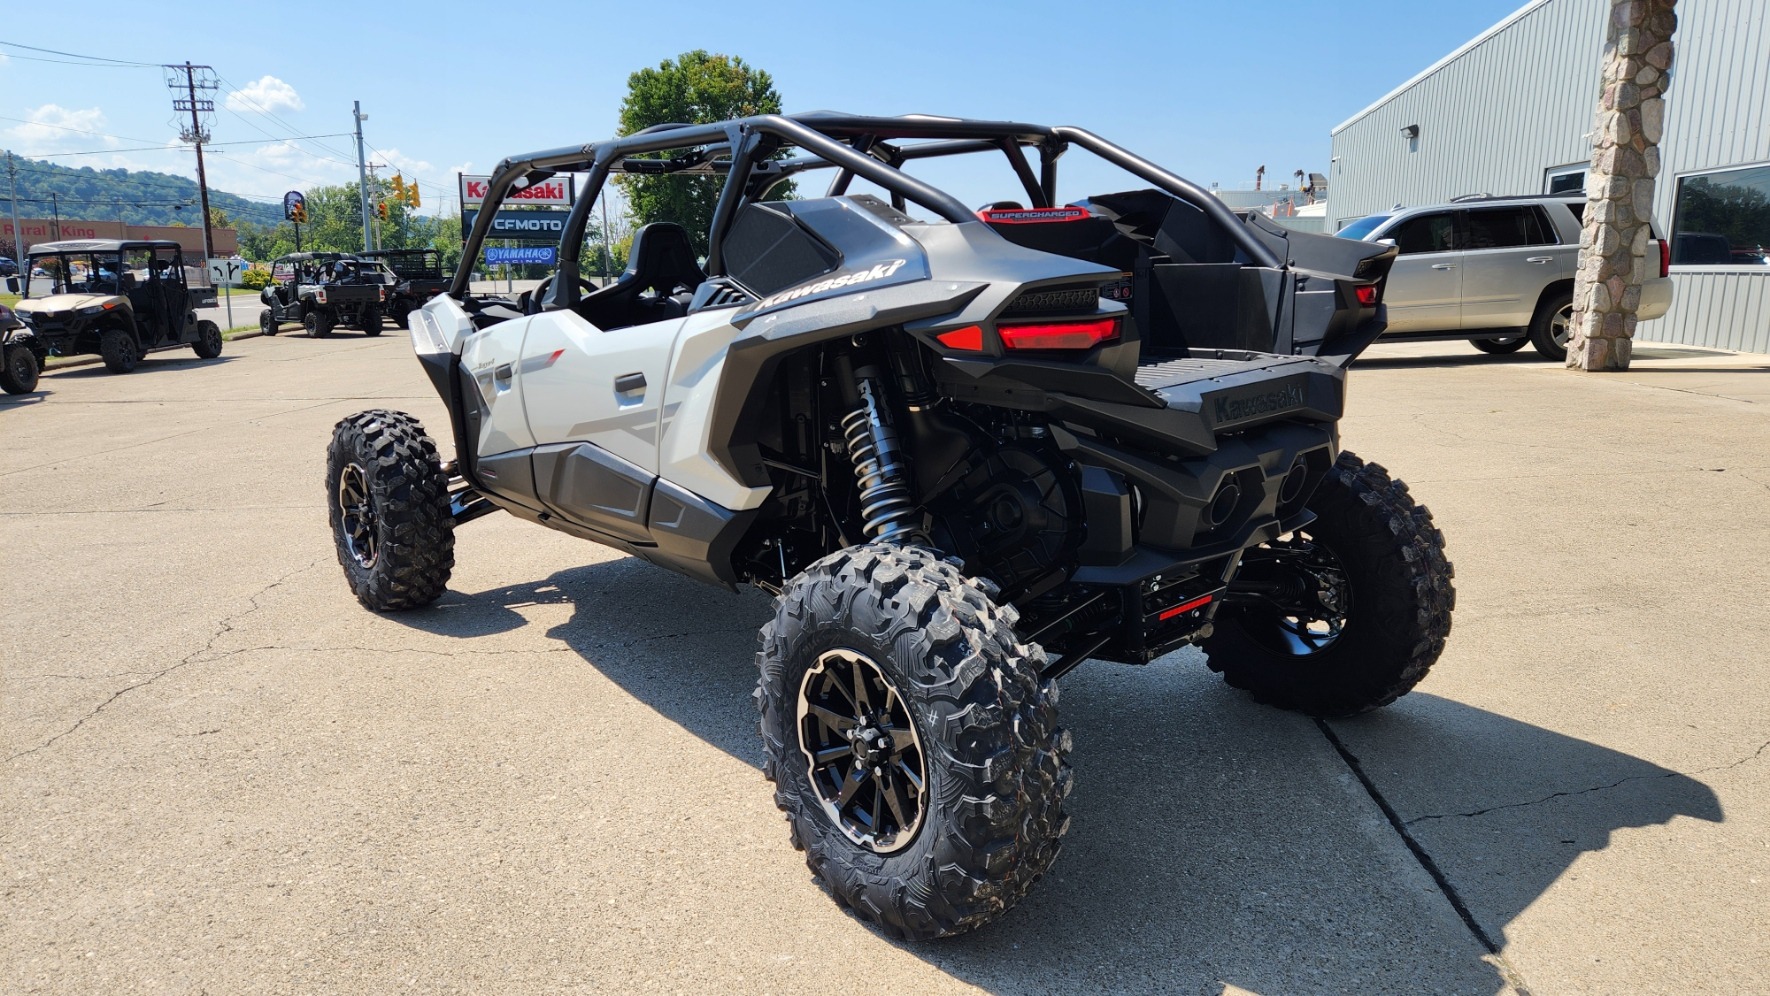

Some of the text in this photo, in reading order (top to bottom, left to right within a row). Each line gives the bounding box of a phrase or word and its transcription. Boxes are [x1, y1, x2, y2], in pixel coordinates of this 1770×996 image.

[467, 181, 564, 200] Kasaki
[991, 205, 1080, 219] SUPERCHARGED
[61, 225, 96, 239] King
[494, 219, 562, 231] CFMOTO
[499, 249, 539, 259] YAMAHA
[752, 259, 906, 312] Kawasaki
[1214, 384, 1304, 423] Kawasaki
